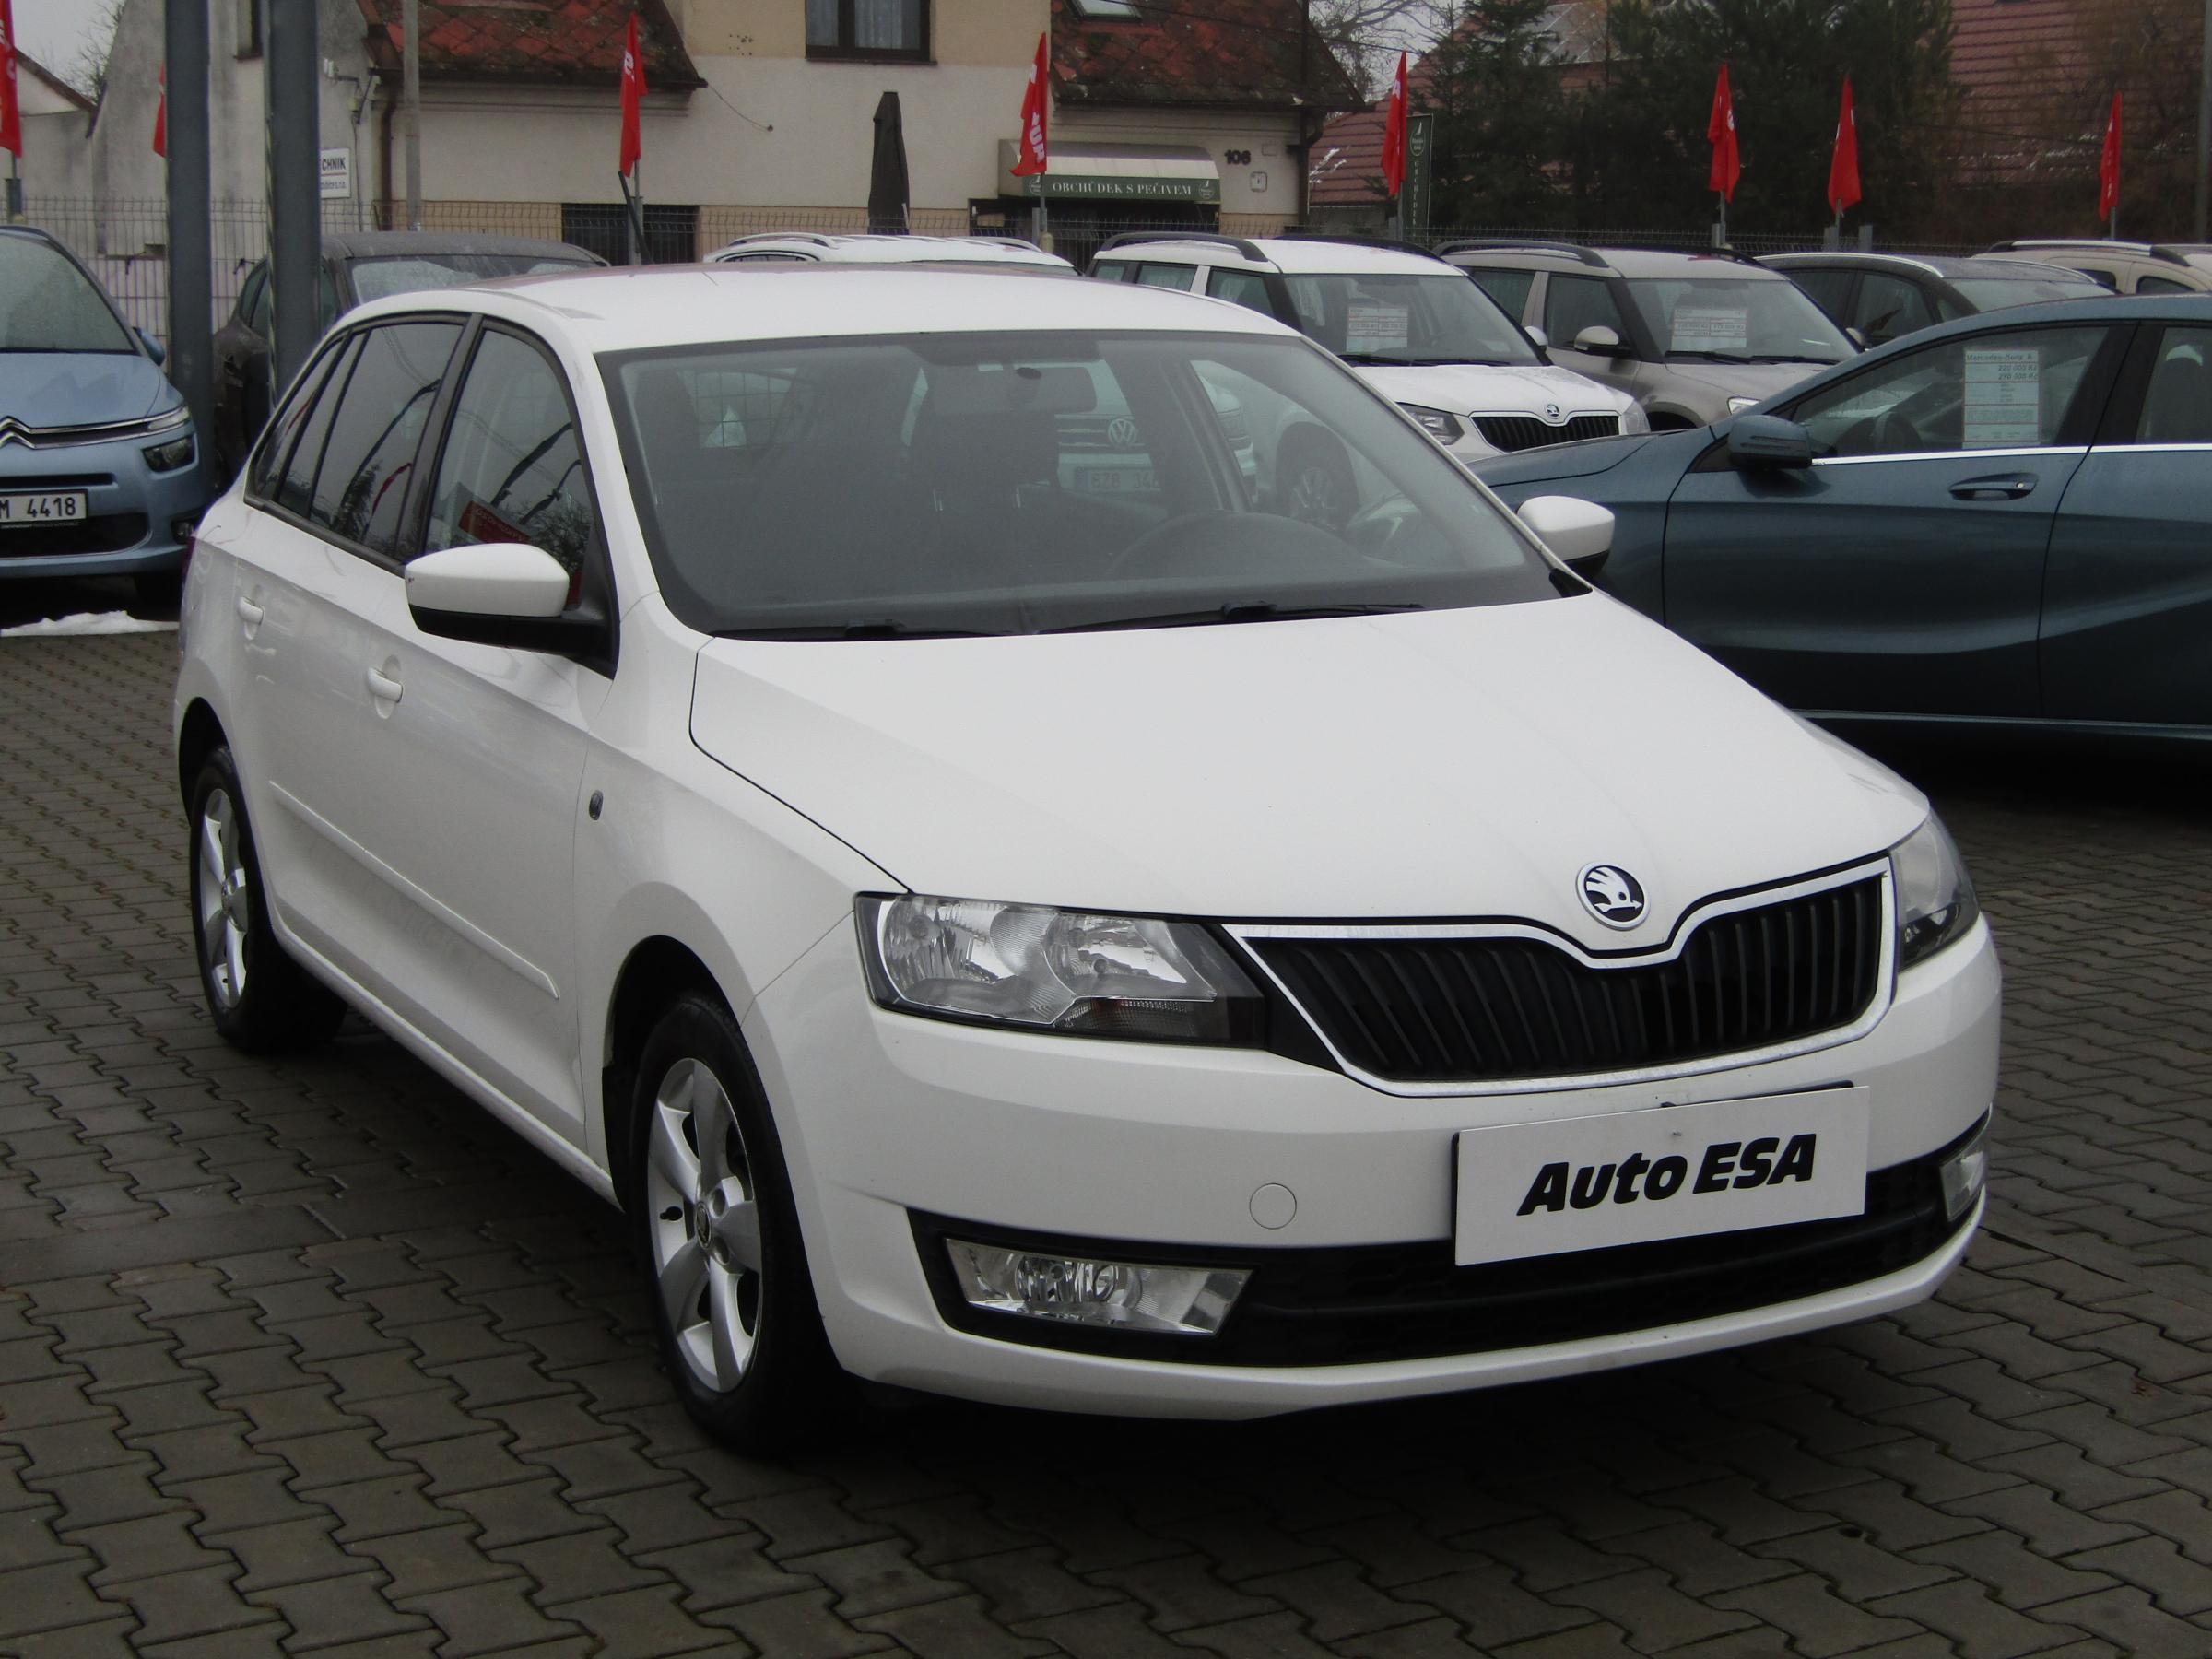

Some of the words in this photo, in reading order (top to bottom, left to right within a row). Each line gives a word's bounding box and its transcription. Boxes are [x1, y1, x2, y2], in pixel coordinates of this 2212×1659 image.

[1224, 149, 1251, 165] 106
[1052, 181, 1124, 194] OBCHŮDEK
[1126, 184, 1134, 194] S
[1137, 182, 1192, 195] PEČIVEM
[27, 496, 76, 518] 4418
[1516, 1152, 1688, 1216] Auto
[1692, 1133, 1817, 1194] ESA
